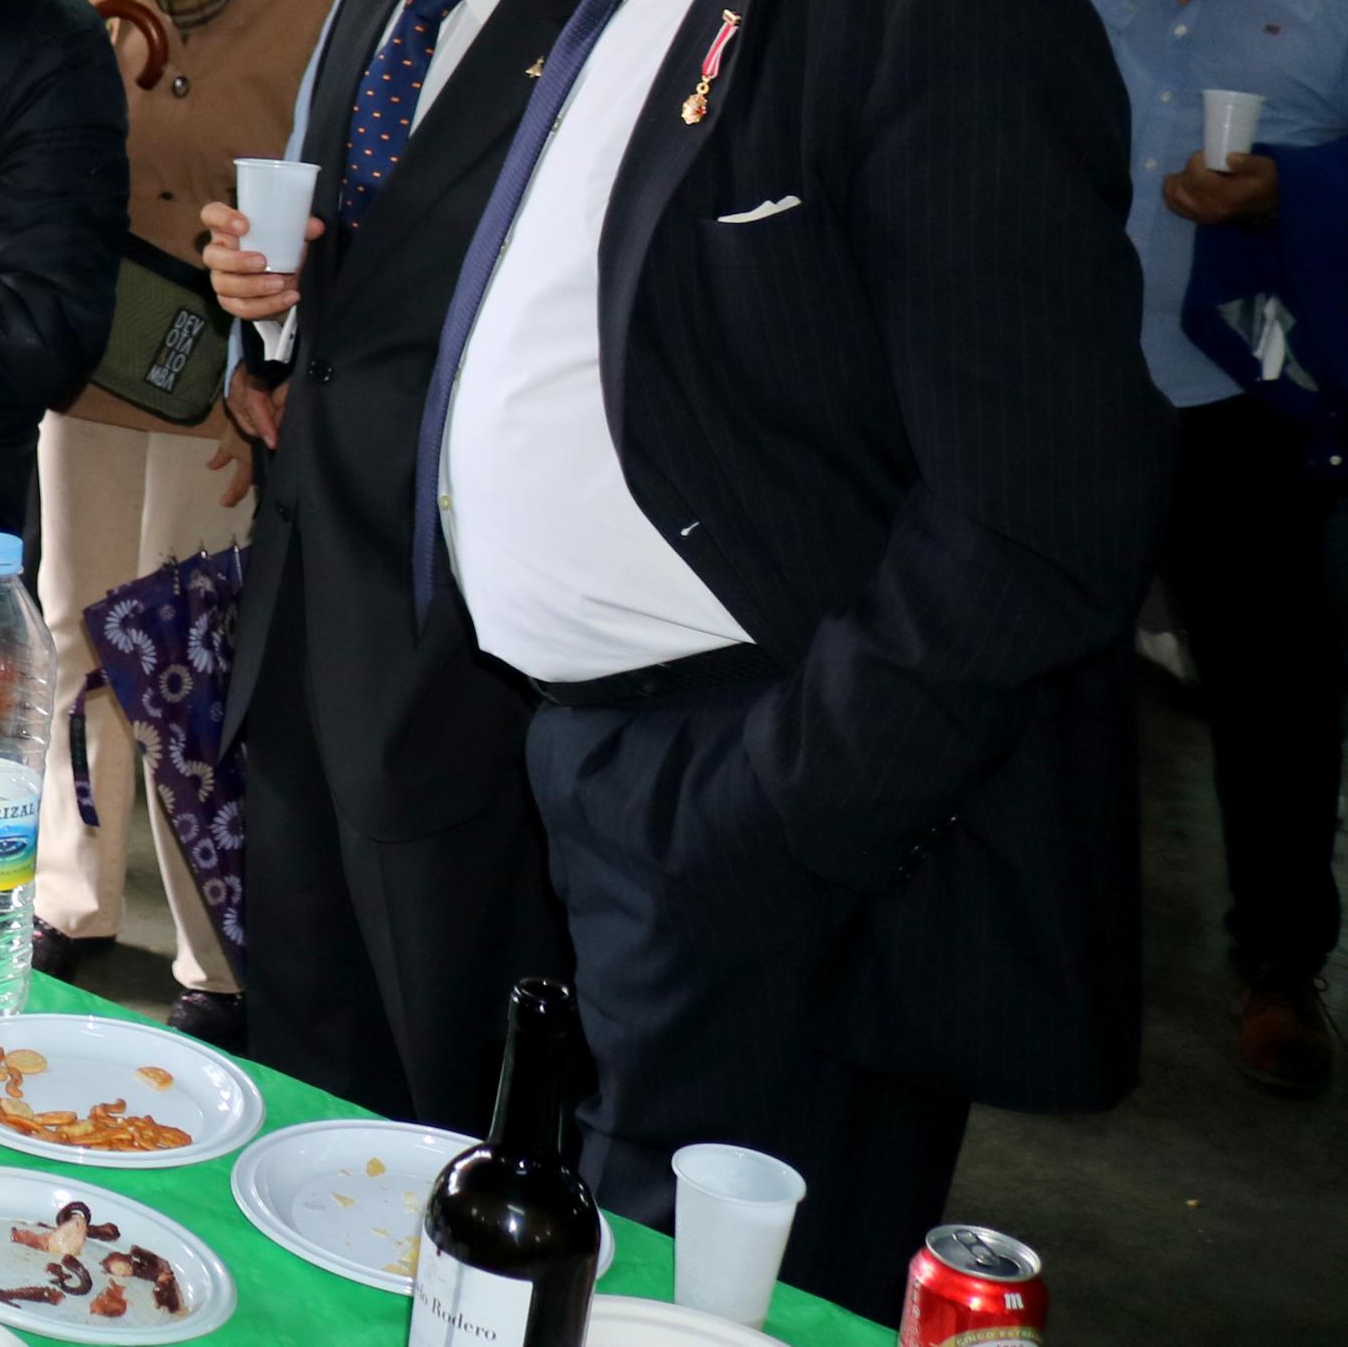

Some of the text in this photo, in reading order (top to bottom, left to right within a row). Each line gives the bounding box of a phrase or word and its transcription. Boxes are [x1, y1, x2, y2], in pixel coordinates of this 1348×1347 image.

[175, 310, 204, 335] DEV
[166, 328, 194, 354] OTA
[431, 1297, 497, 1341] Rodero
